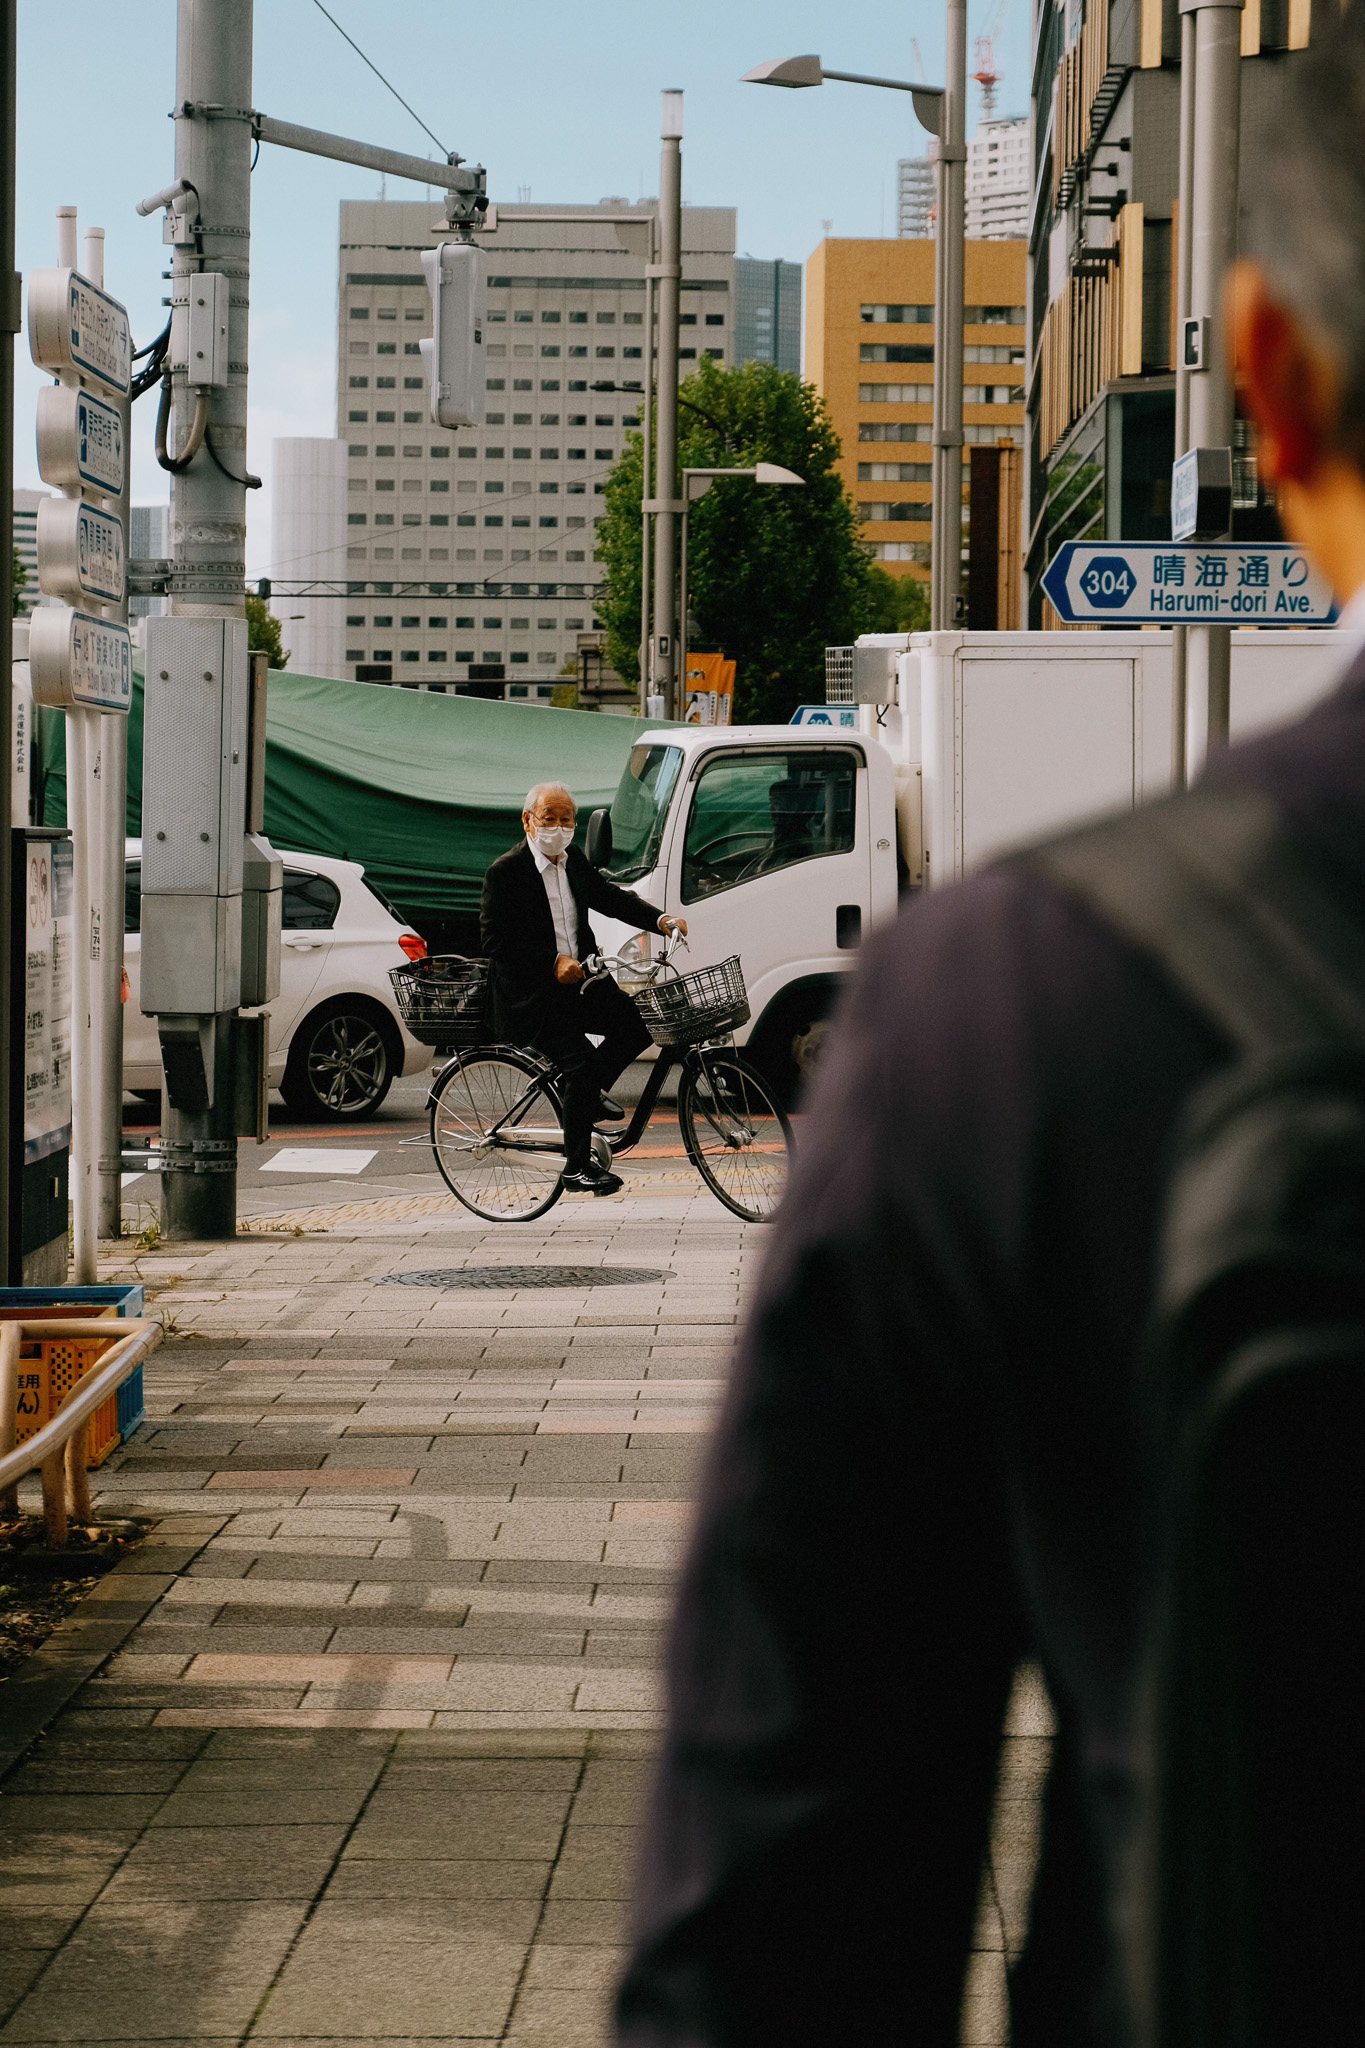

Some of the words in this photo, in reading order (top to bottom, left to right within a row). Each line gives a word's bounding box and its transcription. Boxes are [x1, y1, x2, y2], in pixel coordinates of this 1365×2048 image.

[1086, 570, 1130, 596] 304
[1153, 554, 1310, 588] 晴海通り
[1150, 589, 1268, 613] Harumi-dori
[1274, 590, 1315, 613] Ave.
